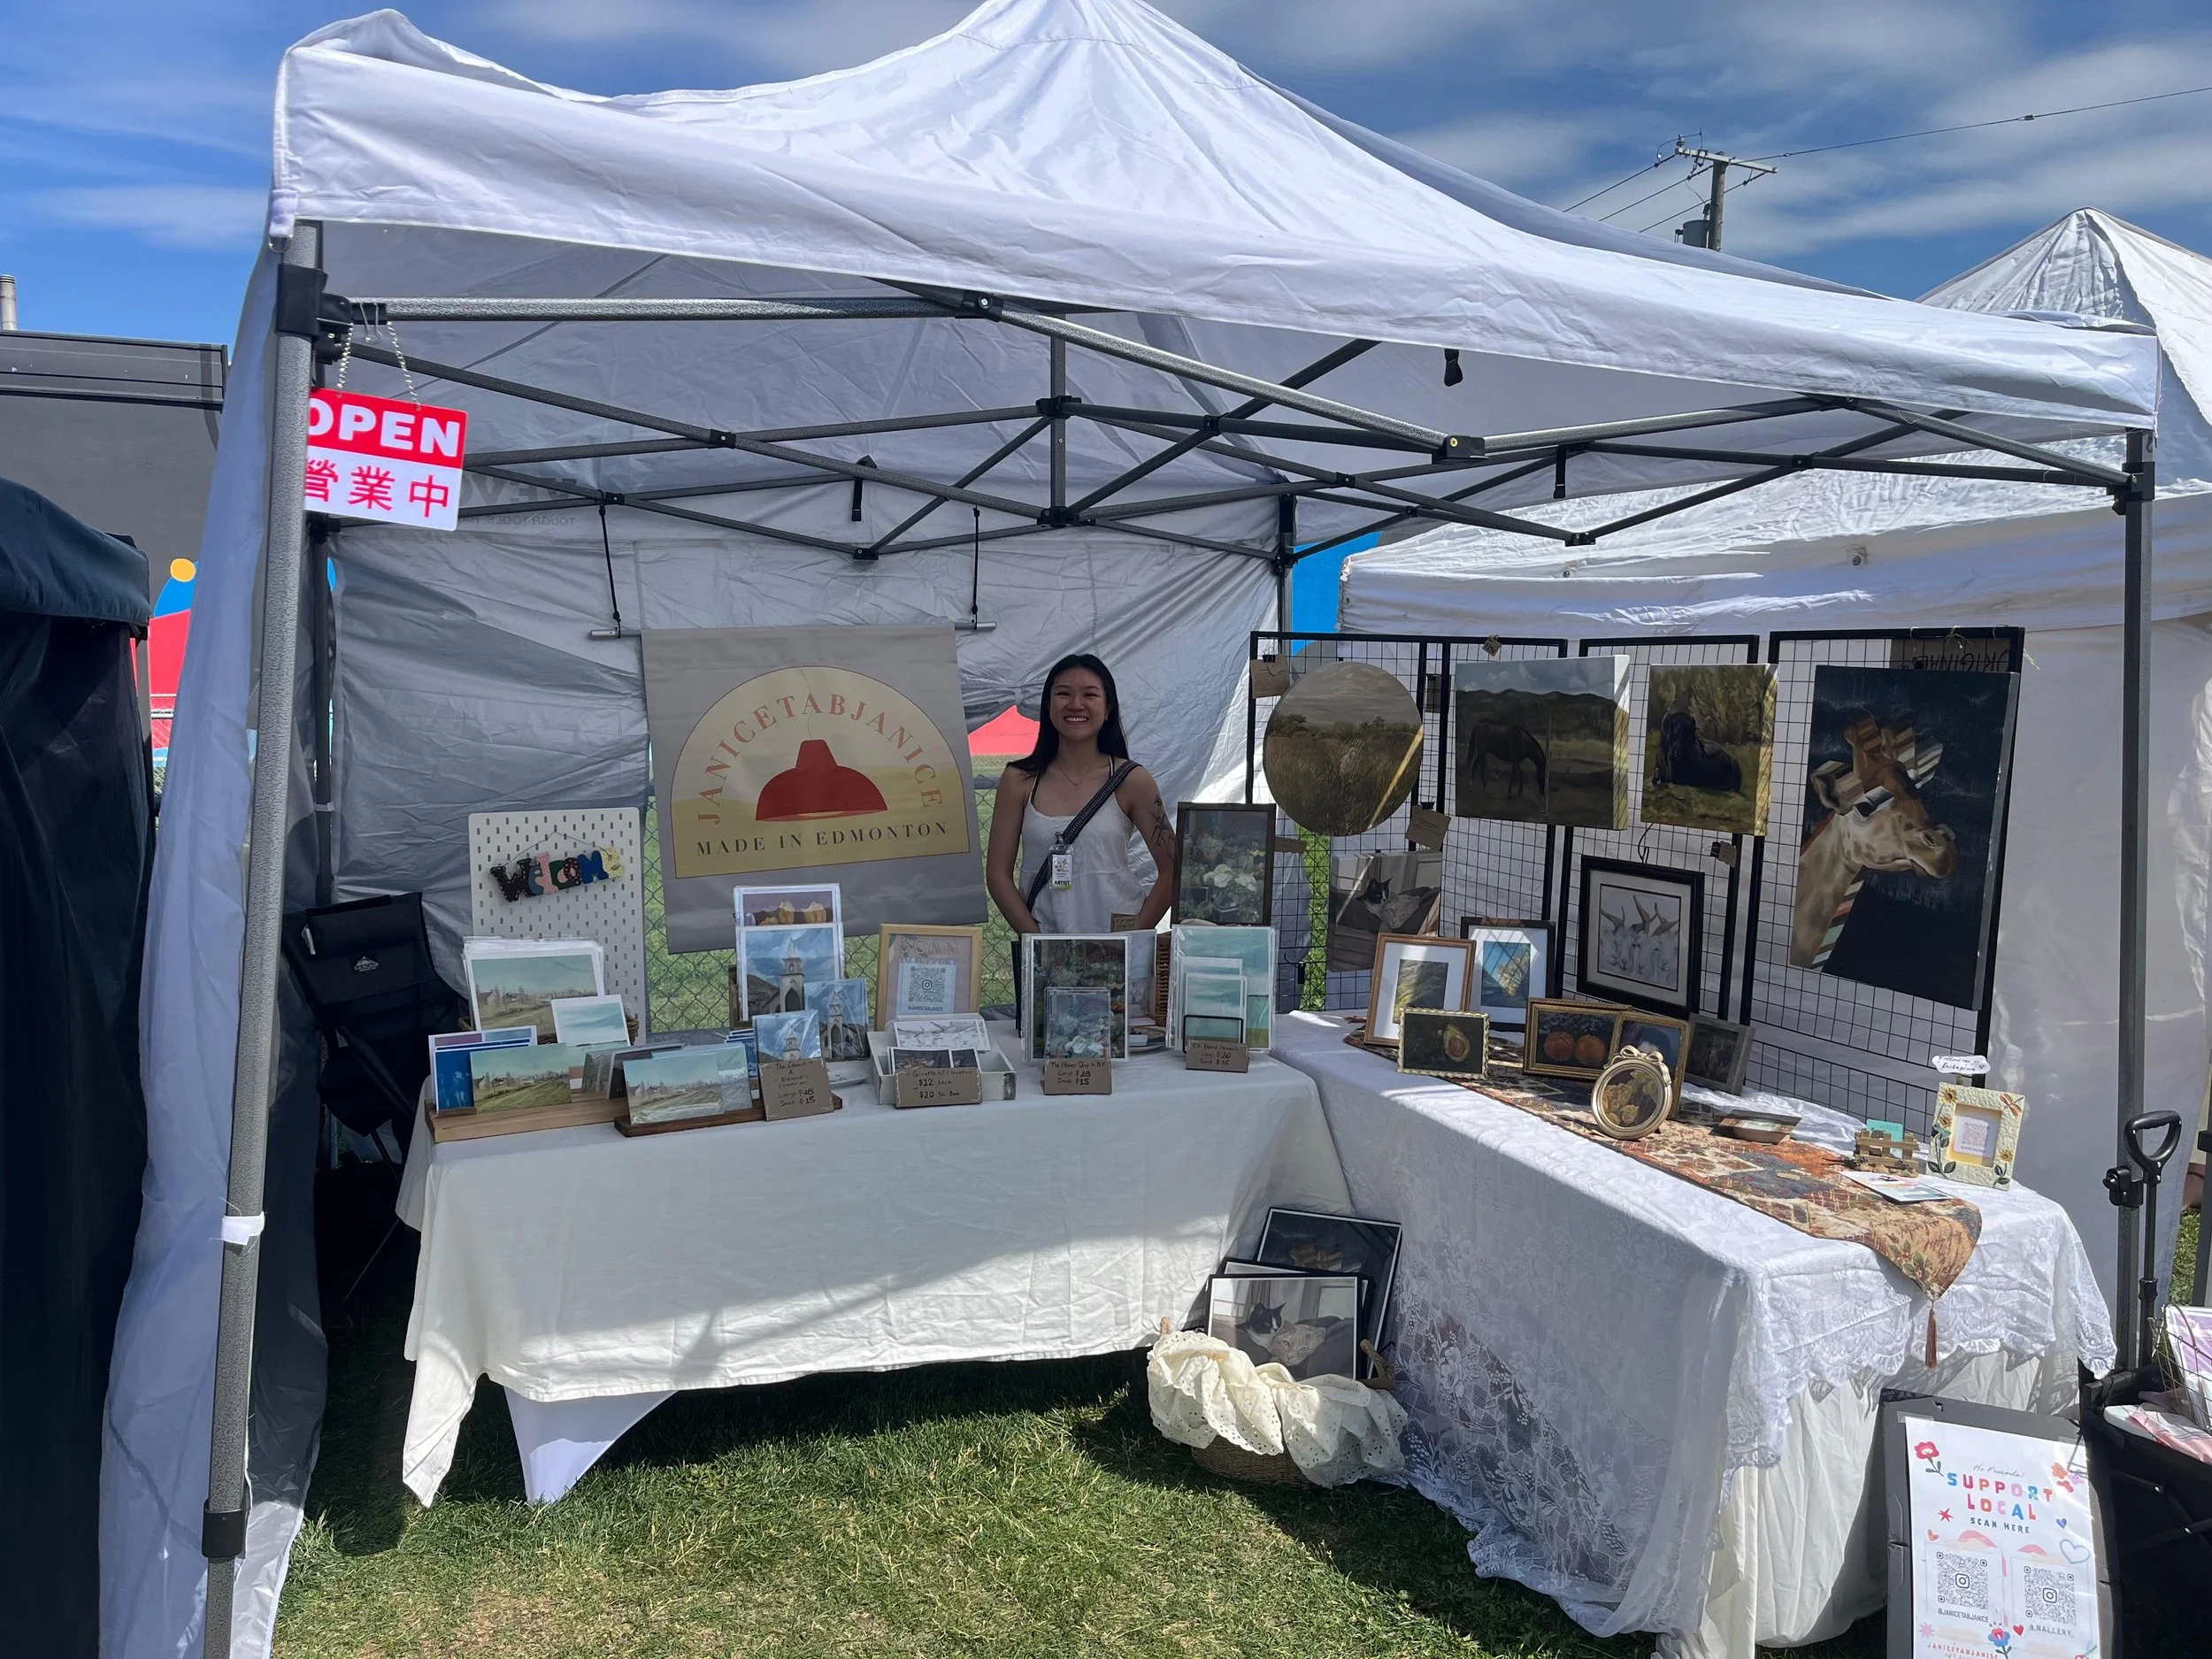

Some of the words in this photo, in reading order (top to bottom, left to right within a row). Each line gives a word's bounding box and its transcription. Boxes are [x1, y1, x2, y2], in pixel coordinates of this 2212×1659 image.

[309, 398, 460, 457] OPEN
[697, 692, 942, 825] JANICETABJANICE
[696, 836, 765, 856] MADE
[780, 833, 803, 849] IN
[816, 822, 948, 846] EDMONTON
[900, 937, 958, 956] SCAN
[1947, 1472, 2053, 1502] SUPPORT
[1967, 1493, 2037, 1520] LOCAL
[1970, 1517, 1997, 1528] SCAN
[2004, 1523, 2030, 1533] HERE
[1938, 1609, 1988, 1623] @JANICETABJANICE
